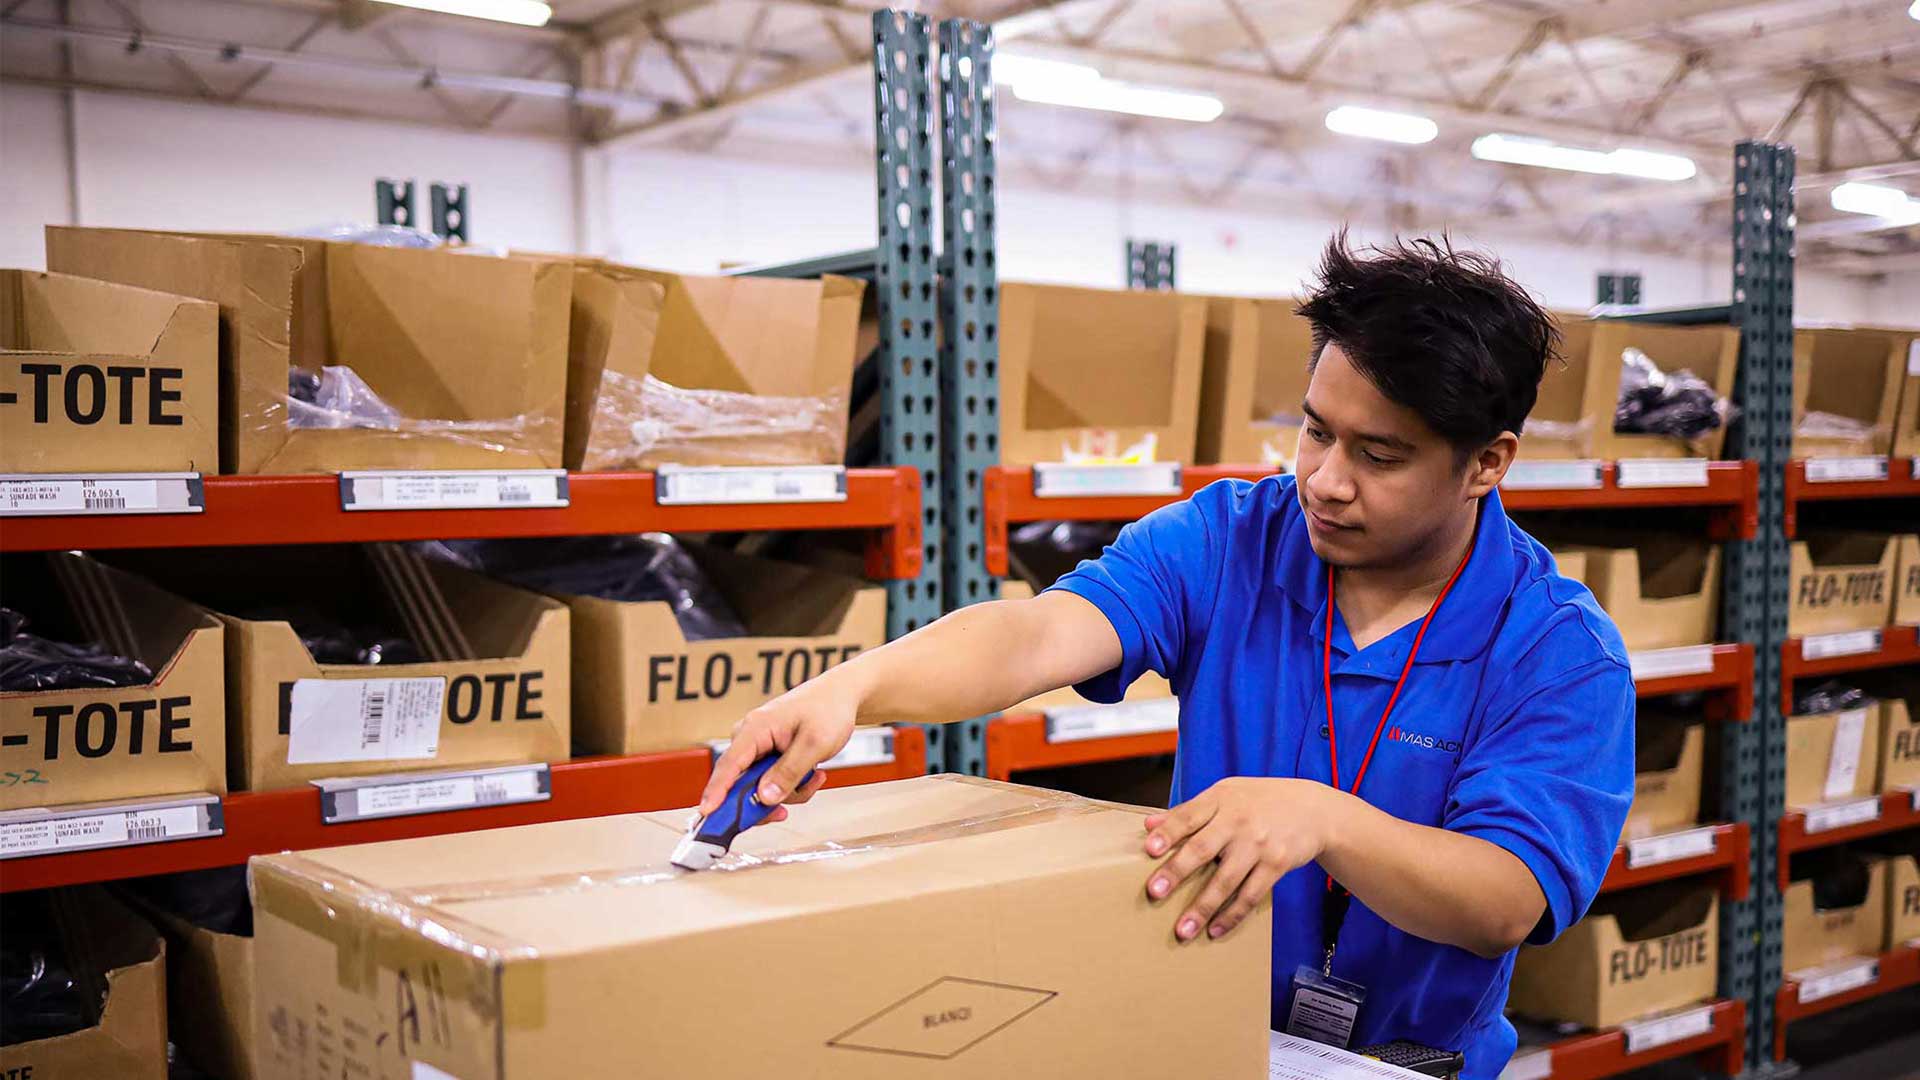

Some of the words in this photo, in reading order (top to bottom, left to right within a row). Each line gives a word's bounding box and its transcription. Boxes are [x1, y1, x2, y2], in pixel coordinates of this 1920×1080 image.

[1798, 571, 1886, 608] FLO-TOTE
[1400, 731, 1434, 748] MAS
[1609, 930, 1706, 986] FLO-TOTE
